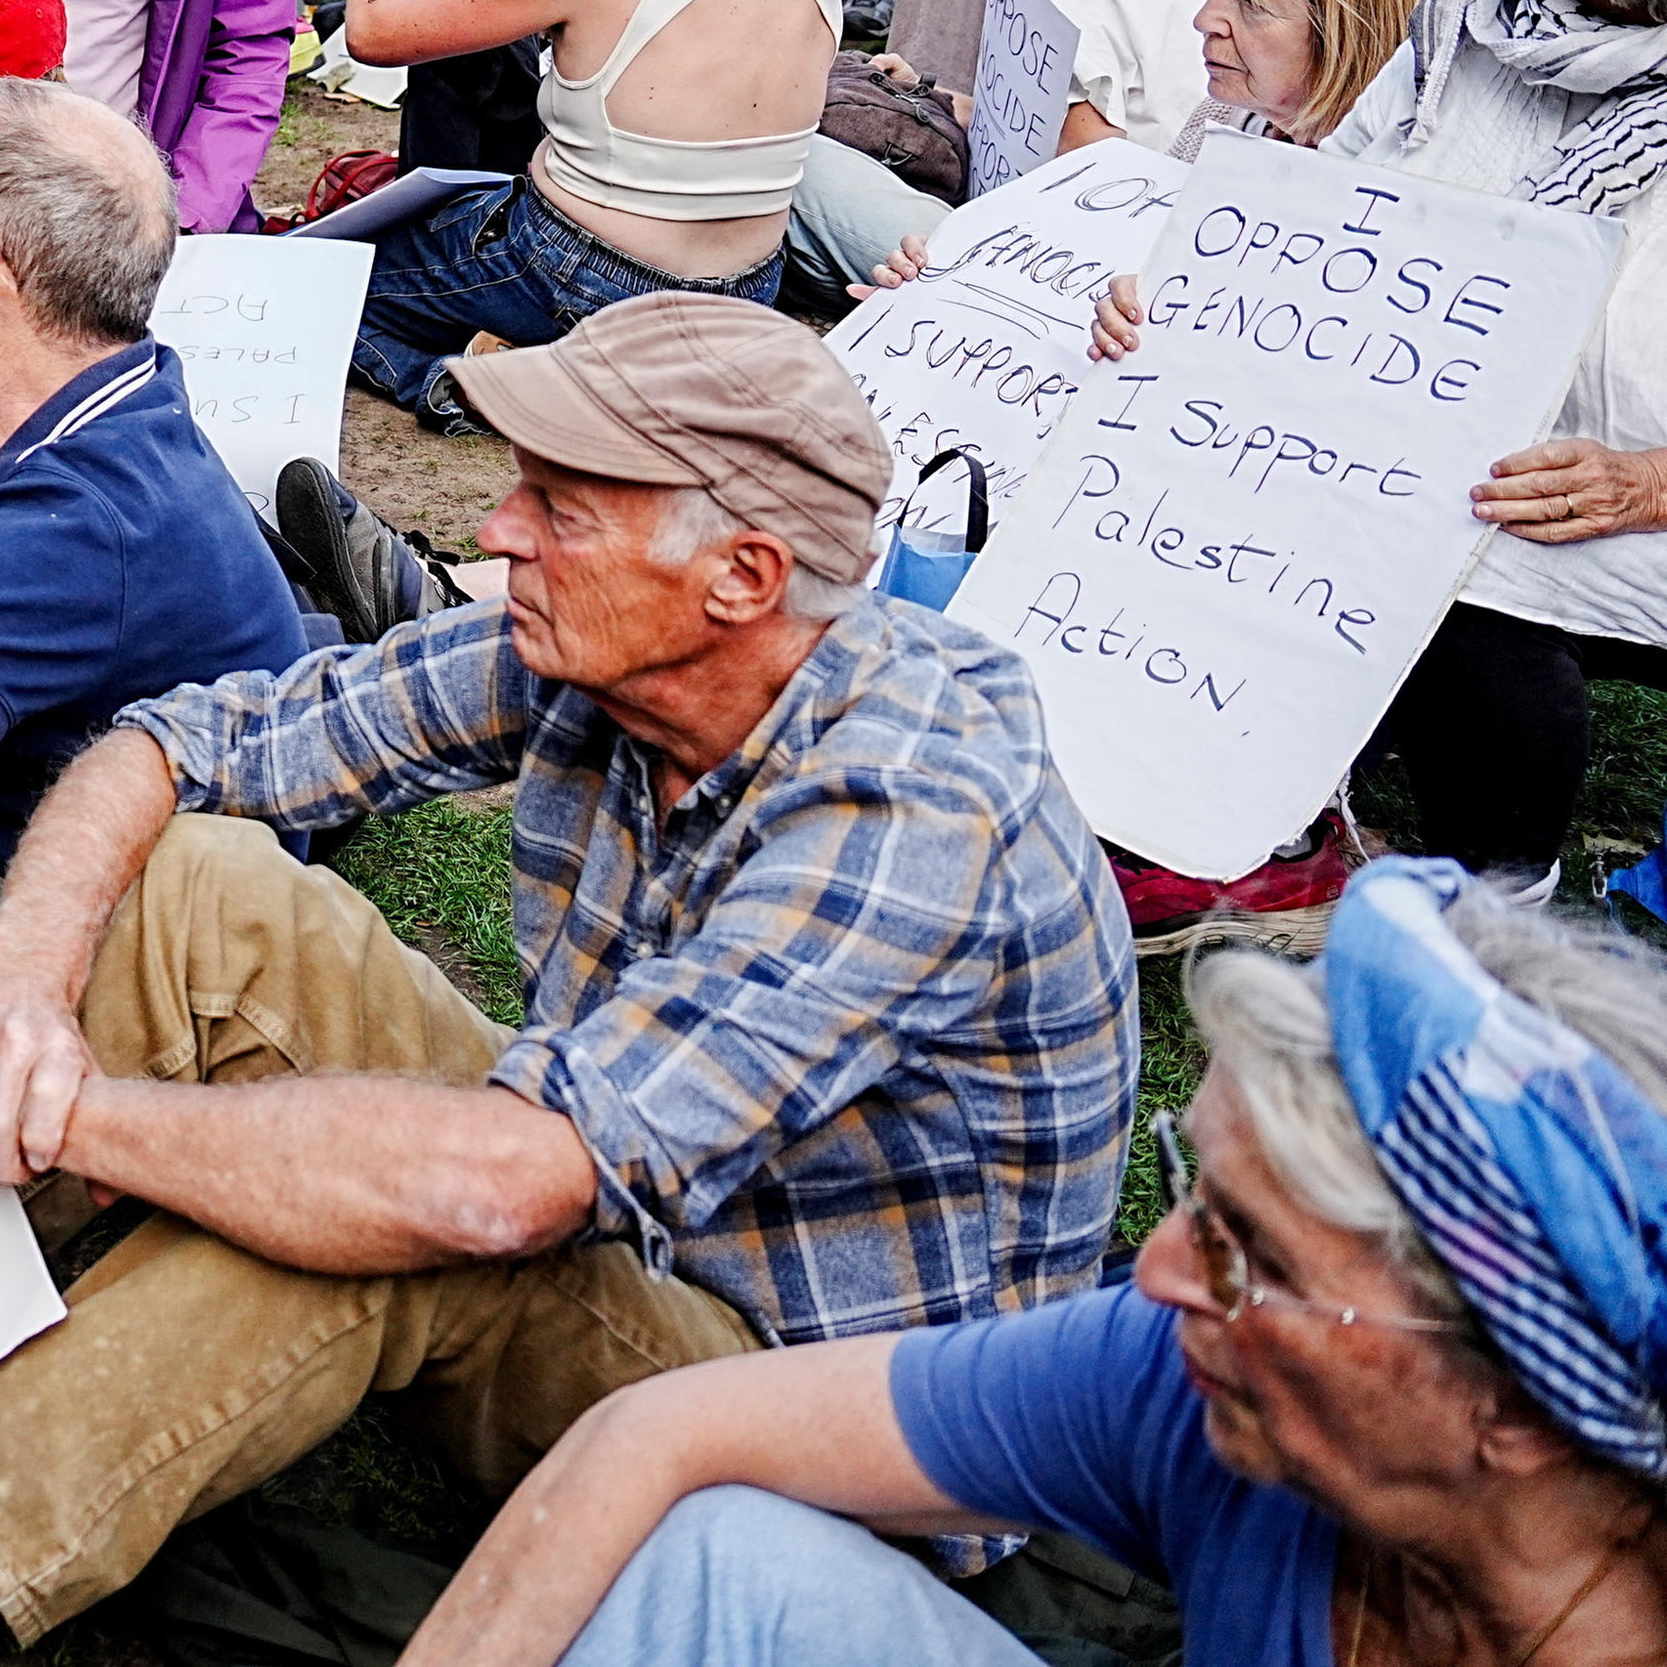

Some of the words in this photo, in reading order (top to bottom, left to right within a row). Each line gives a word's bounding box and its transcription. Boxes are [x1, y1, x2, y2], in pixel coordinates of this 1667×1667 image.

[1039, 163, 1097, 193] I
[1342, 186, 1400, 236] I
[1194, 205, 1512, 336] OPPOSE
[848, 304, 895, 352] I
[1148, 274, 1483, 402] GENOCIDE
[283, 394, 306, 424] I
[1098, 374, 1159, 431] I
[1052, 454, 1377, 655] Palestine
